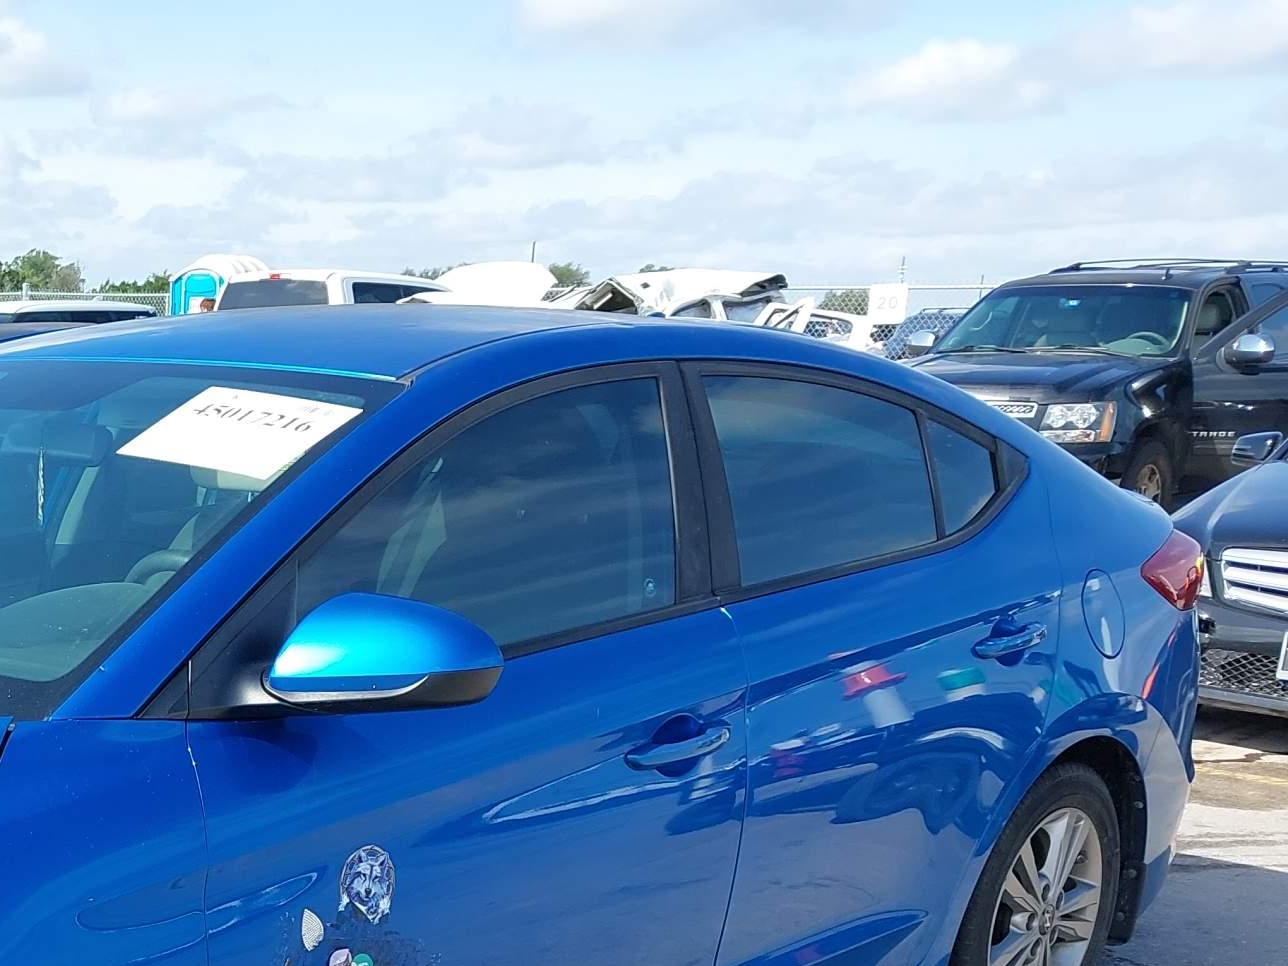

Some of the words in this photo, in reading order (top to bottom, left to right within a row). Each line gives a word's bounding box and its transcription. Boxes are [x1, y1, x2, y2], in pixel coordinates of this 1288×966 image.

[876, 296, 899, 310] 20
[193, 403, 313, 433] 45017216
[1188, 430, 1236, 438] TAHOE
